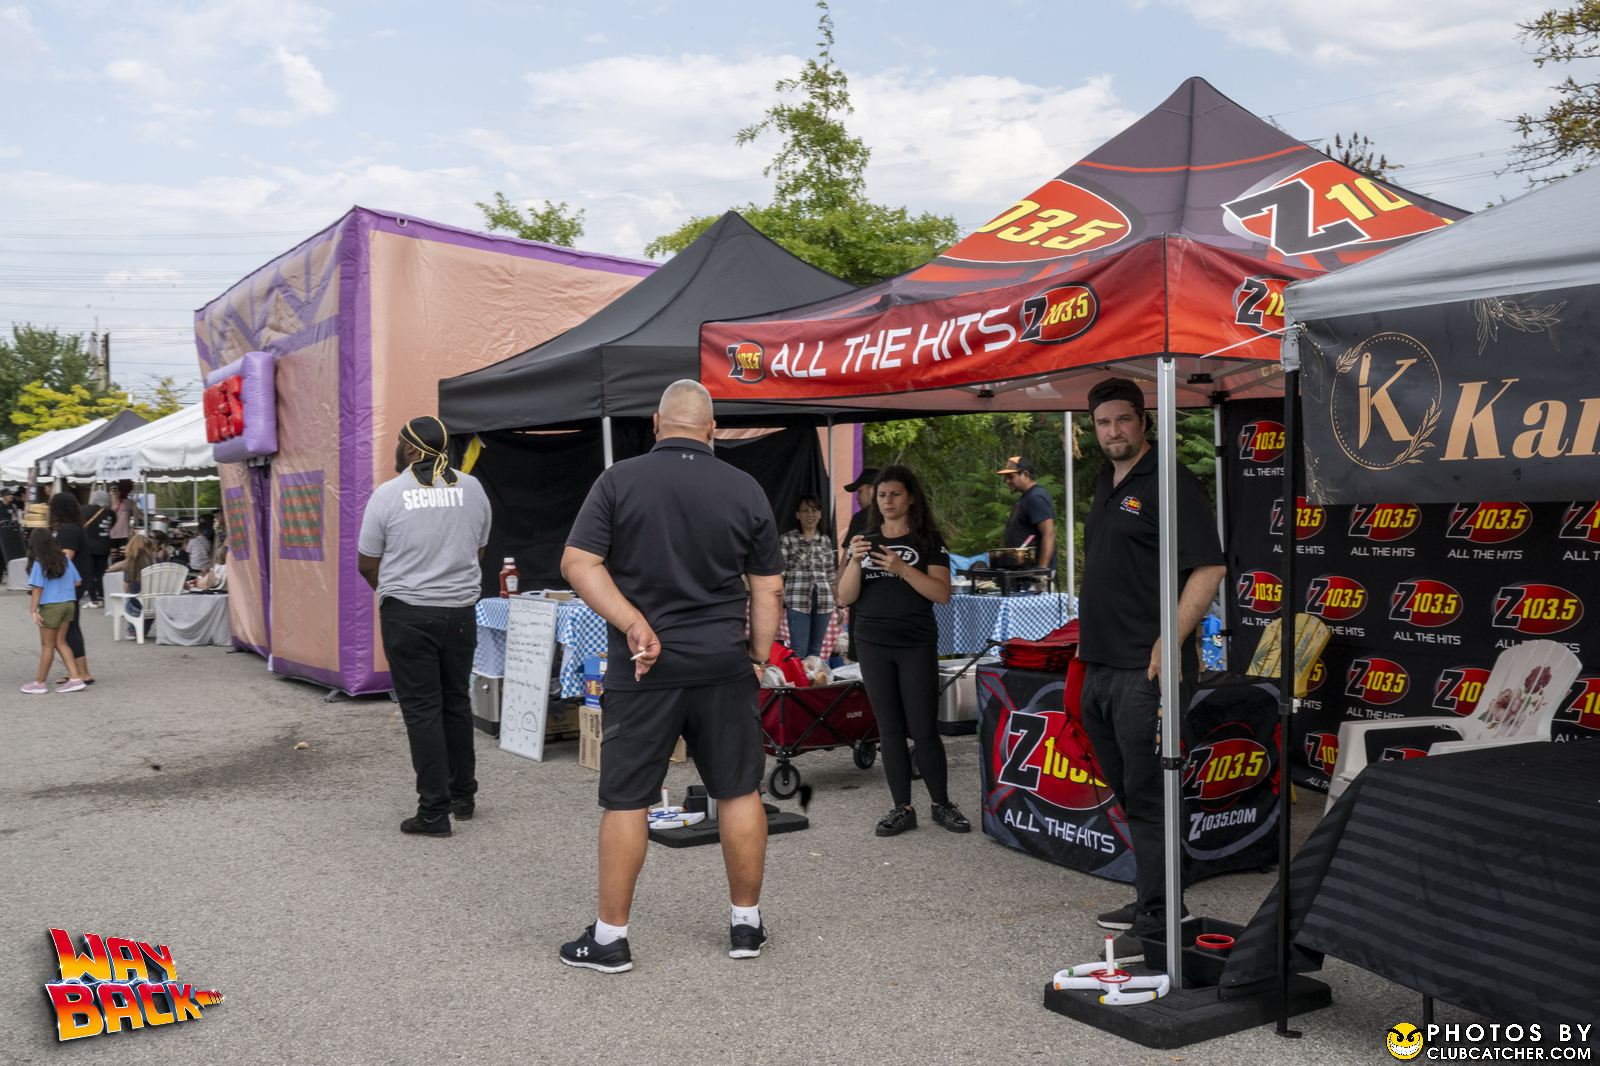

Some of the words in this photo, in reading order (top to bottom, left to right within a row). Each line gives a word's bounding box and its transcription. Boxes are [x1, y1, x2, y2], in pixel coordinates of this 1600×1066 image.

[1221, 178, 1413, 256] Z10
[771, 341, 827, 378] ALL
[841, 326, 912, 374] THE
[912, 304, 1017, 365] HITS
[1243, 468, 1256, 476] ALL
[1256, 467, 1270, 476] THE
[402, 487, 464, 511] SECURITY
[1273, 544, 1284, 553] AL
[1305, 545, 1325, 555] HITS
[1350, 547, 1370, 556] ALL
[1371, 547, 1391, 557] THE
[1391, 547, 1416, 557] HITS
[1447, 549, 1470, 559] ALL
[1473, 549, 1495, 560] THE
[1496, 550, 1523, 560] HITS
[1562, 550, 1590, 561] ALL
[865, 572, 880, 580] ALL
[1345, 626, 1366, 637] HITS
[1393, 631, 1414, 642] ALL
[1415, 632, 1437, 643] THE
[1437, 634, 1461, 645] HITS
[1304, 700, 1323, 711] HITS
[1346, 707, 1364, 718] ALL
[1366, 708, 1383, 720] THE
[1188, 807, 1257, 842] Z1035.COM
[1004, 808, 1040, 833] ALL
[1044, 816, 1077, 843] THE
[1076, 826, 1115, 854] HITS
